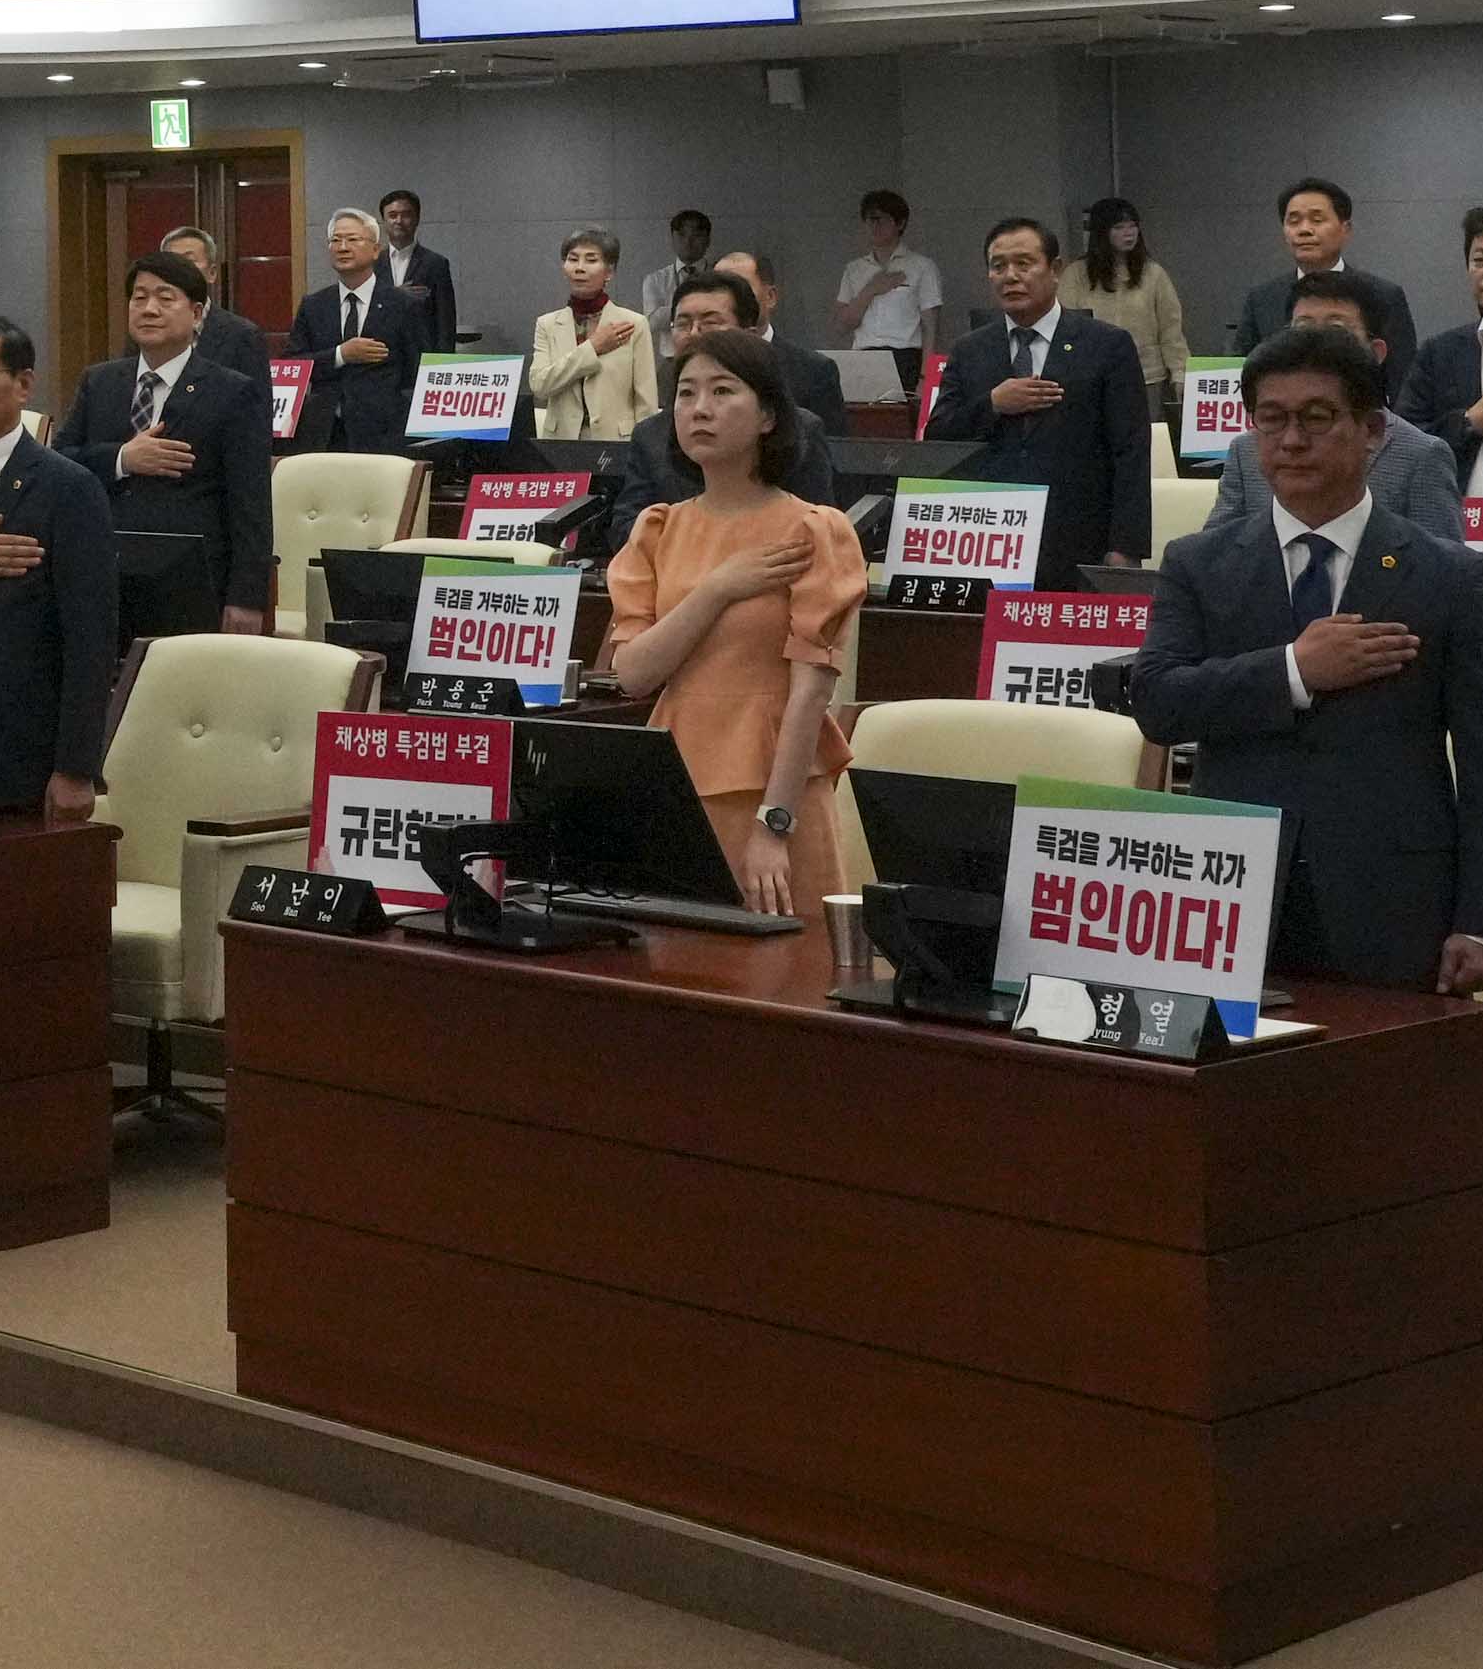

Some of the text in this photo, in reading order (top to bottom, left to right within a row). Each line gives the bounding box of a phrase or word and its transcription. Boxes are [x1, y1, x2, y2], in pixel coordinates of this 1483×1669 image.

[426, 372, 510, 388] 특검을 거부하는 자가
[422, 389, 506, 419] 범인이다!
[480, 480, 576, 498] 채상병 특검법 부결
[907, 502, 1028, 528] 특검을 거부하는 자가
[902, 527, 1024, 570] 범인이다!
[434, 587, 560, 618] 특검을 거부하는 자가
[1003, 601, 1148, 630] 채상병 특검법 부결
[427, 616, 556, 669] 범인이다!
[334, 725, 491, 765] 채상병 특검법 부결
[1036, 824, 1246, 889] 특검을 거부하는 자가
[1029, 872, 1241, 973] 범인이다!
[1091, 1027, 1122, 1043] yung
